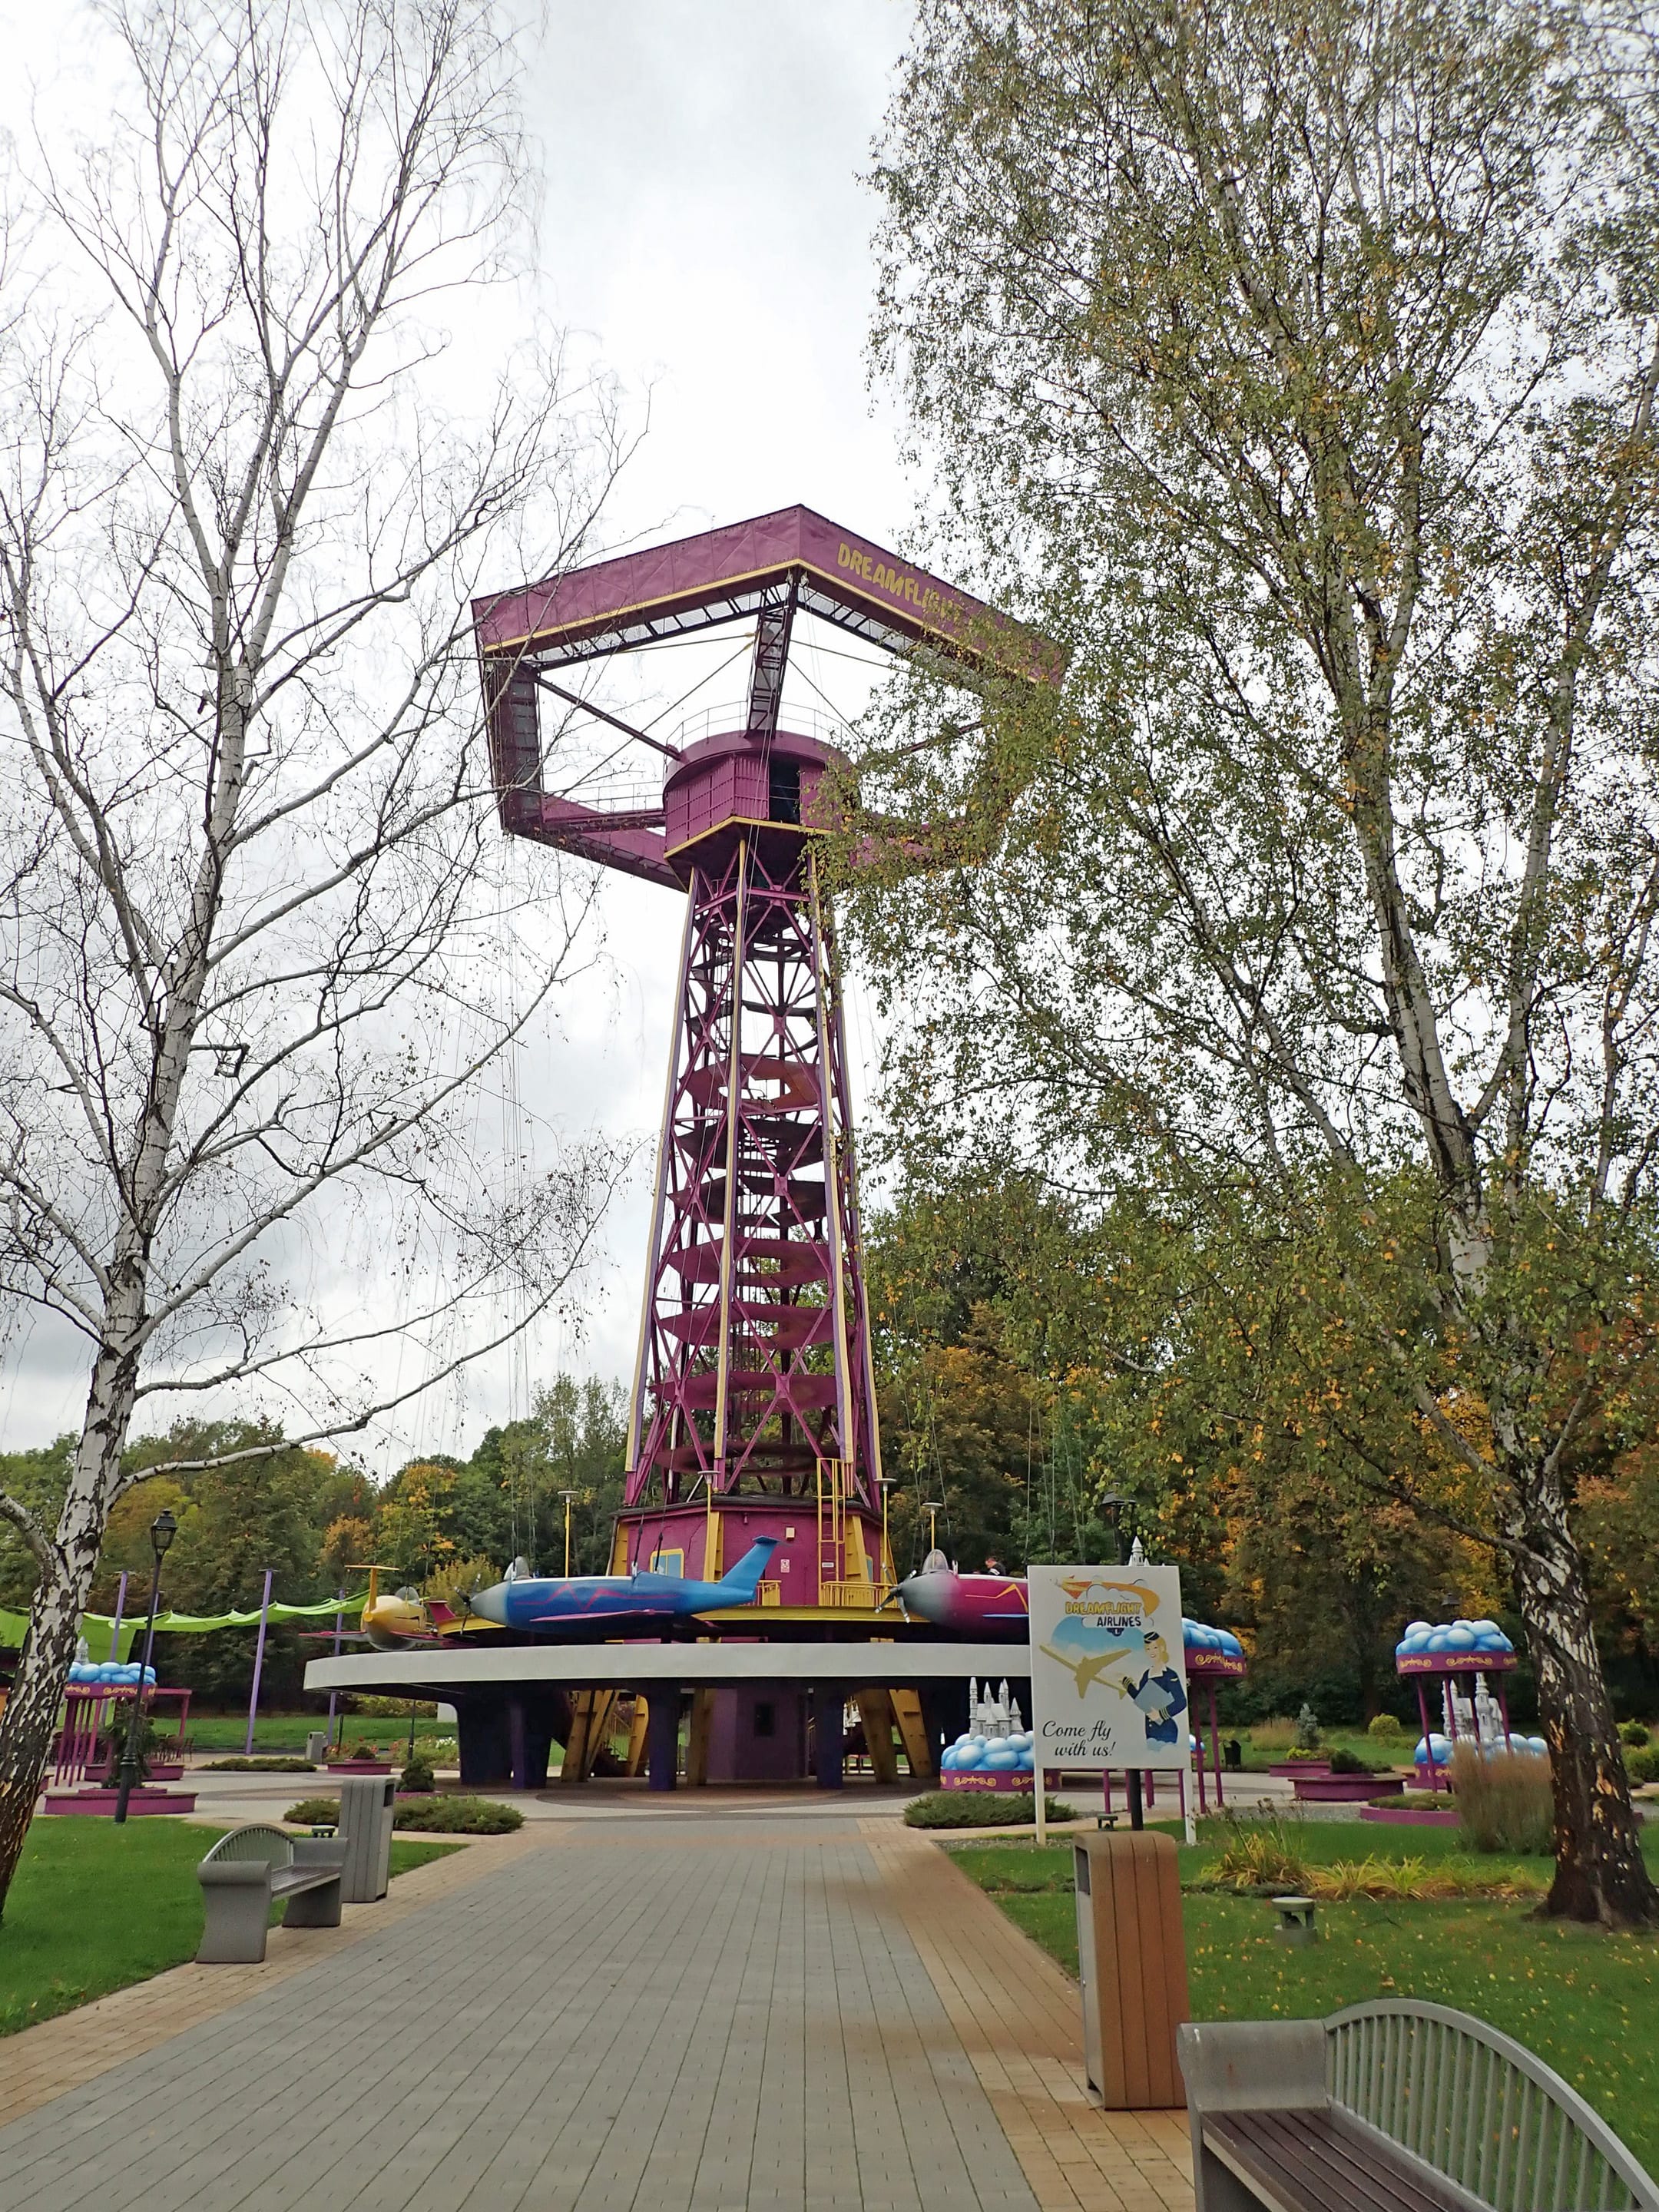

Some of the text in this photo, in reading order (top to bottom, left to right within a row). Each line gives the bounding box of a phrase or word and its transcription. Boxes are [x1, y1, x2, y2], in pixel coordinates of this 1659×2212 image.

[1065, 1601, 1142, 1614] DREAMFLIGHT
[1097, 1616, 1141, 1627] AIRLINES
[1042, 1720, 1111, 1742] Come fly
[1055, 1740, 1116, 1757] with us!
